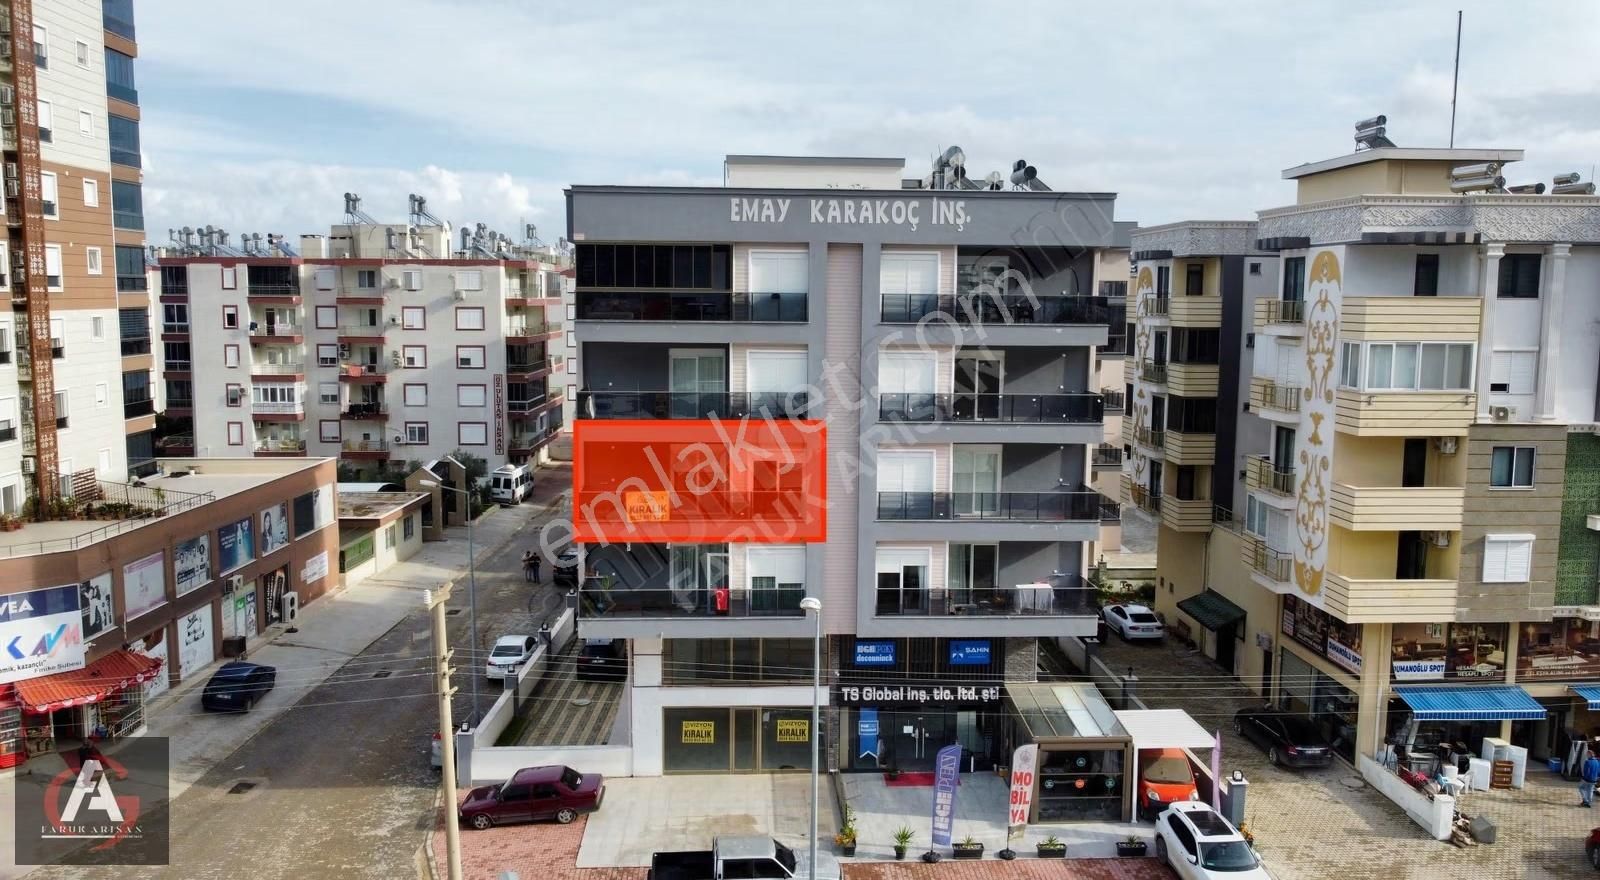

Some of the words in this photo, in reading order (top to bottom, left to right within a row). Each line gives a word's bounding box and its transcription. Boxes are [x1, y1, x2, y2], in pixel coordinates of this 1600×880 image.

[730, 198, 791, 223] EMAY
[810, 199, 920, 232] KARAKOÇ
[931, 196, 972, 232] İNŞ.
[628, 503, 667, 514] KIRALIK
[1394, 662, 1428, 673] DUMANOĞLU
[1429, 664, 1445, 673] SPOT
[841, 687, 860, 701] TS
[862, 686, 903, 701] Global
[907, 686, 930, 703] inş.
[957, 685, 979, 700] ltd.
[684, 729, 712, 738] KIRALIK
[779, 728, 806, 737] KIRALIK
[1013, 771, 1032, 786] MO
[934, 754, 957, 830] EGEPEN
[1010, 787, 1030, 805] BİL
[1011, 810, 1025, 823] YA
